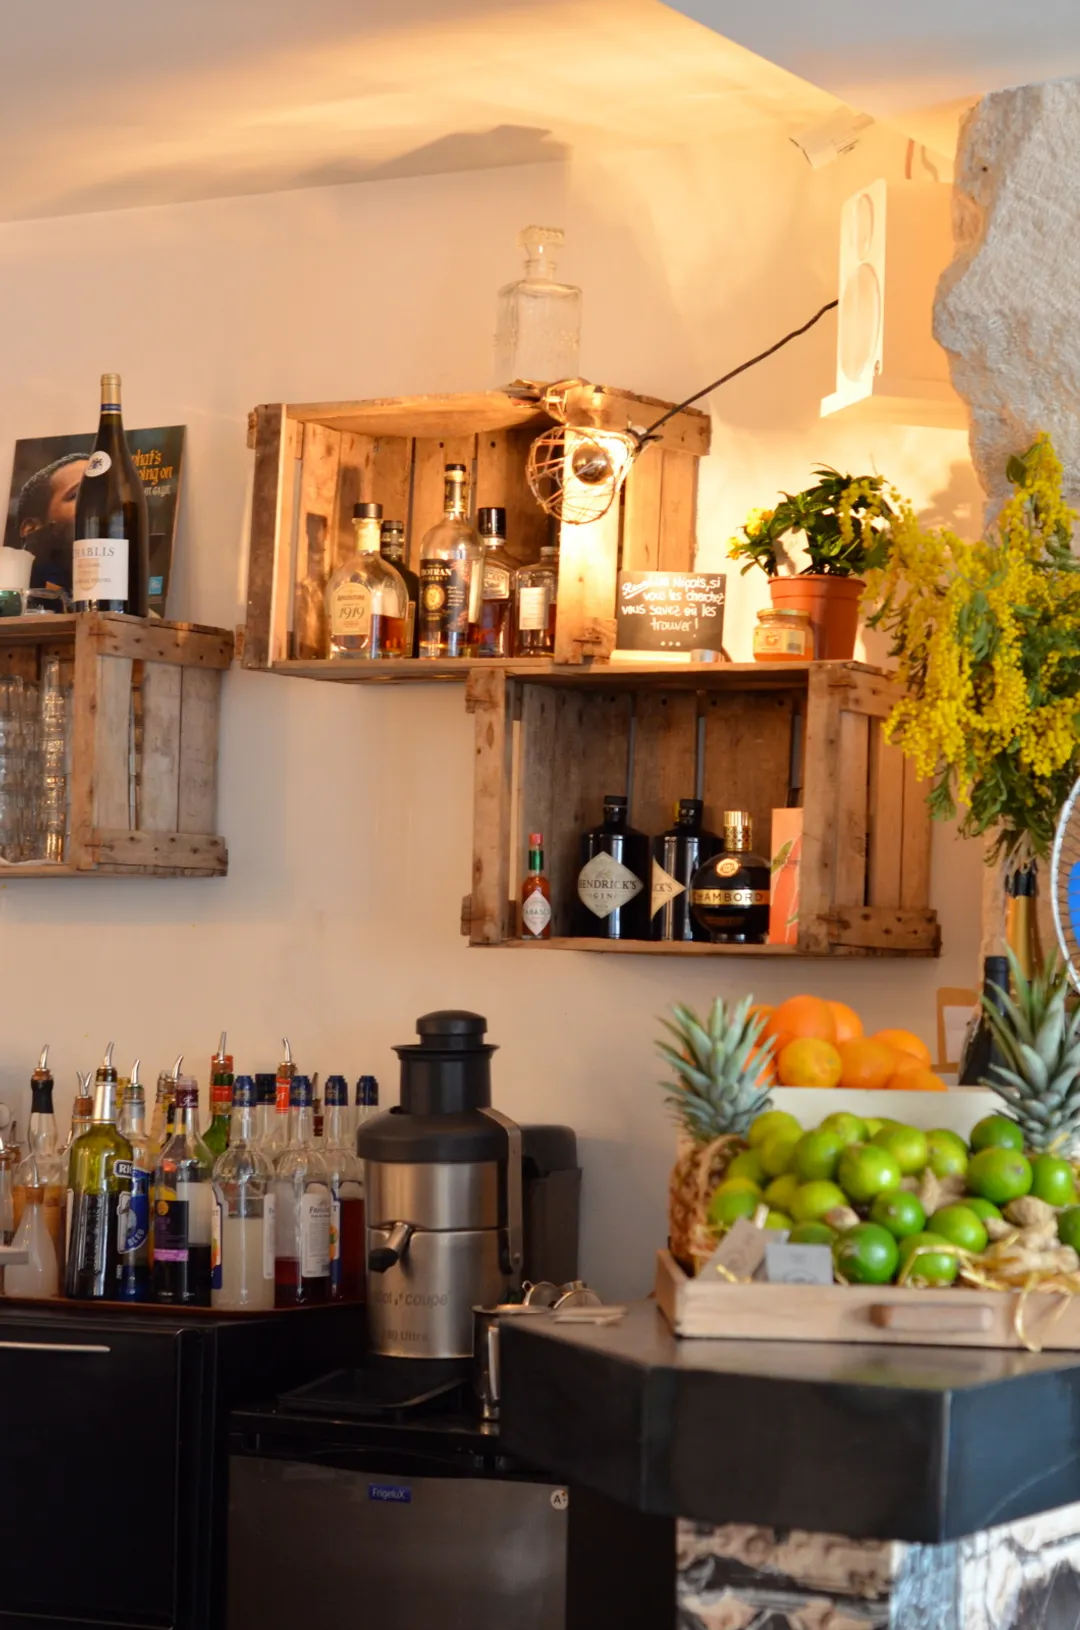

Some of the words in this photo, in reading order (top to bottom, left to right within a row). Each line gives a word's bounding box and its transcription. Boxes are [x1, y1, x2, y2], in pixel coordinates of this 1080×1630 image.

[131, 449, 162, 466] hat's
[138, 466, 159, 486] oing
[160, 466, 173, 479] on
[74, 546, 115, 557] HABLIS
[339, 606, 365, 619] 1919
[621, 603, 646, 615] vous
[701, 603, 717, 617] les
[580, 879, 637, 890] HENDRICK'S
[592, 892, 613, 900] GIN
